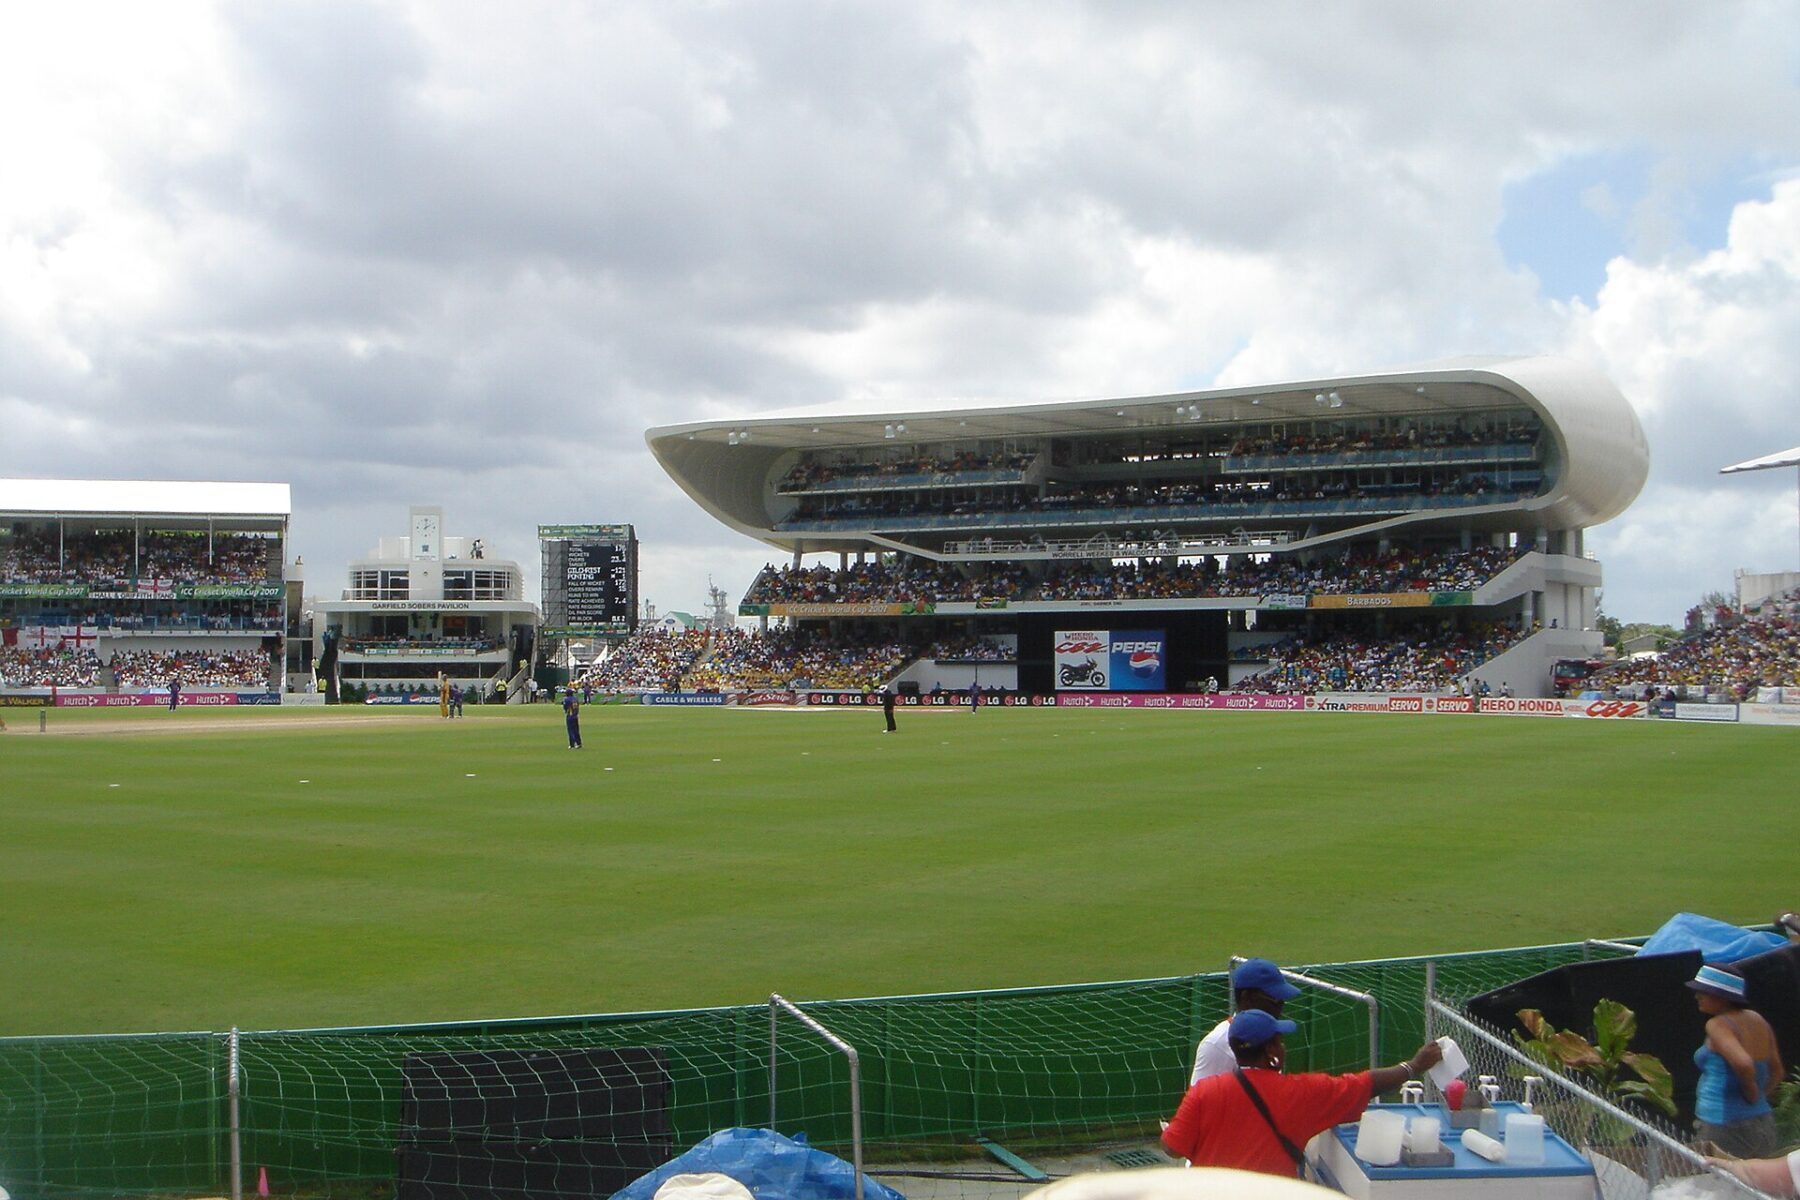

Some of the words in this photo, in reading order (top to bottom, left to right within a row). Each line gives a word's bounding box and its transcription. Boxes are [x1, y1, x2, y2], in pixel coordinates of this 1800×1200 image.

[49, 588, 64, 596] Cup
[221, 587, 243, 595] World
[244, 588, 260, 597] Cup
[260, 587, 280, 595] 2007
[1347, 597, 1392, 605] BARBADOS
[828, 605, 850, 613] World
[852, 606, 867, 614] Cup
[1111, 641, 1161, 653] PEPSI
[821, 695, 834, 704] LG
[848, 695, 861, 704] LG
[877, 695, 884, 704] L
[905, 696, 917, 705] LG
[932, 696, 945, 705] LG
[960, 696, 972, 705] LG
[987, 697, 1000, 705] LG
[1015, 697, 1027, 705] LG
[1043, 697, 1055, 705] LG
[1390, 700, 1420, 711] SERVO
[1437, 701, 1469, 711] SERVO
[1481, 701, 1515, 711] HERO
[1518, 701, 1563, 711] HONDA
